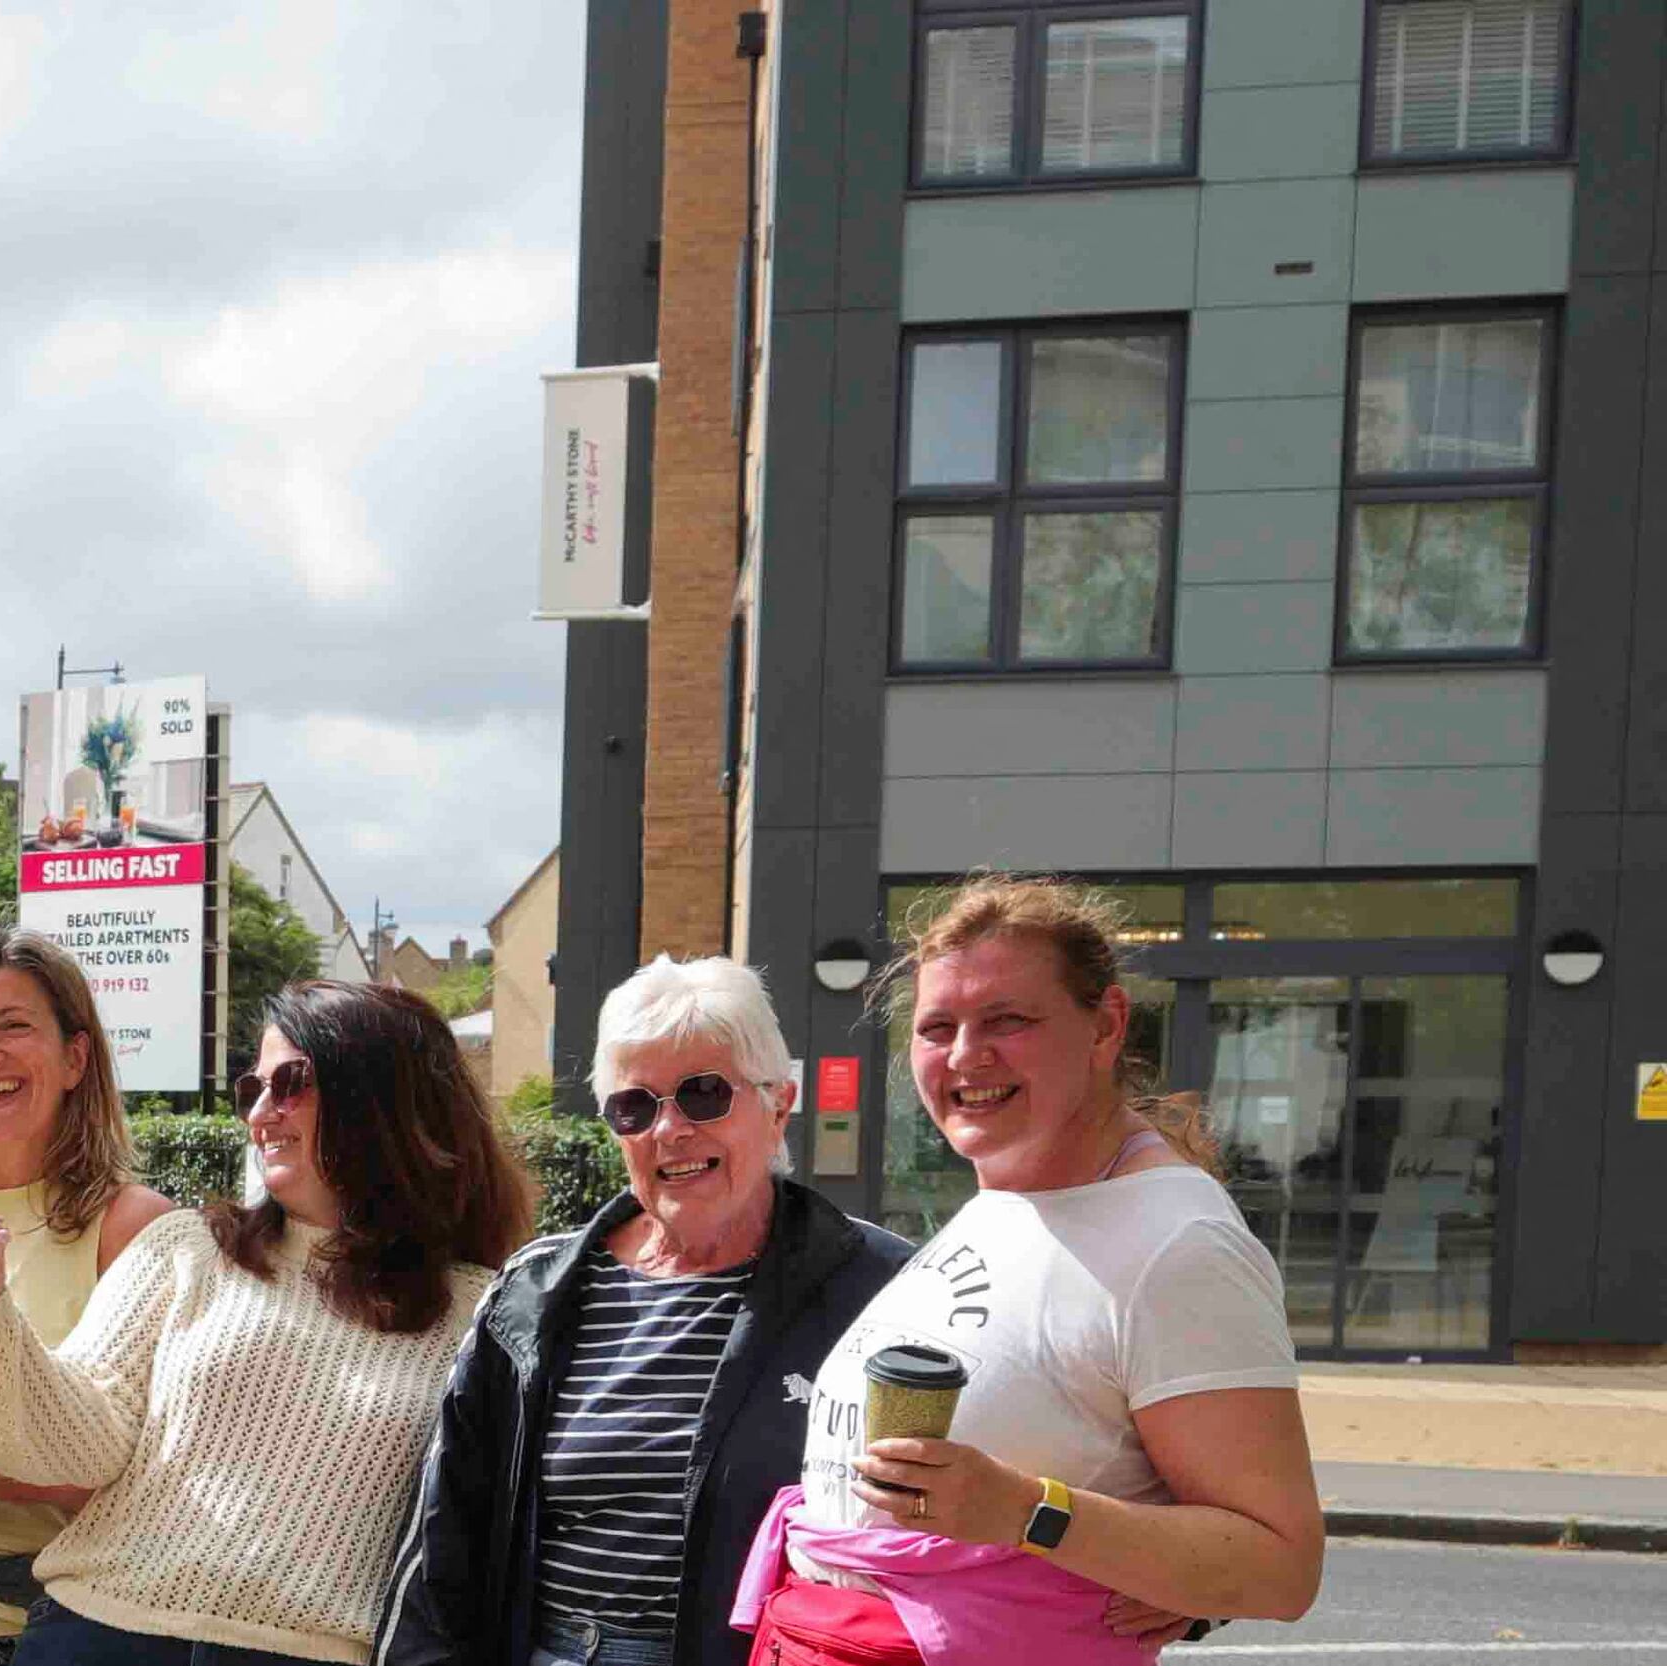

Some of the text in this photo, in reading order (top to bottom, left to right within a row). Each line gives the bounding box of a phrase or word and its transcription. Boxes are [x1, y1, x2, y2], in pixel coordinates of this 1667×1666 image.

[566, 430, 579, 477] STONE
[164, 698, 191, 714] 90%
[160, 719, 194, 735] SOLD
[41, 853, 181, 884] SELLING FAST
[66, 909, 156, 929] BEAUTIFULLY
[97, 928, 191, 946] APARTMENTS
[77, 948, 171, 966] THE OVER 60s
[118, 1027, 152, 1040] STONE
